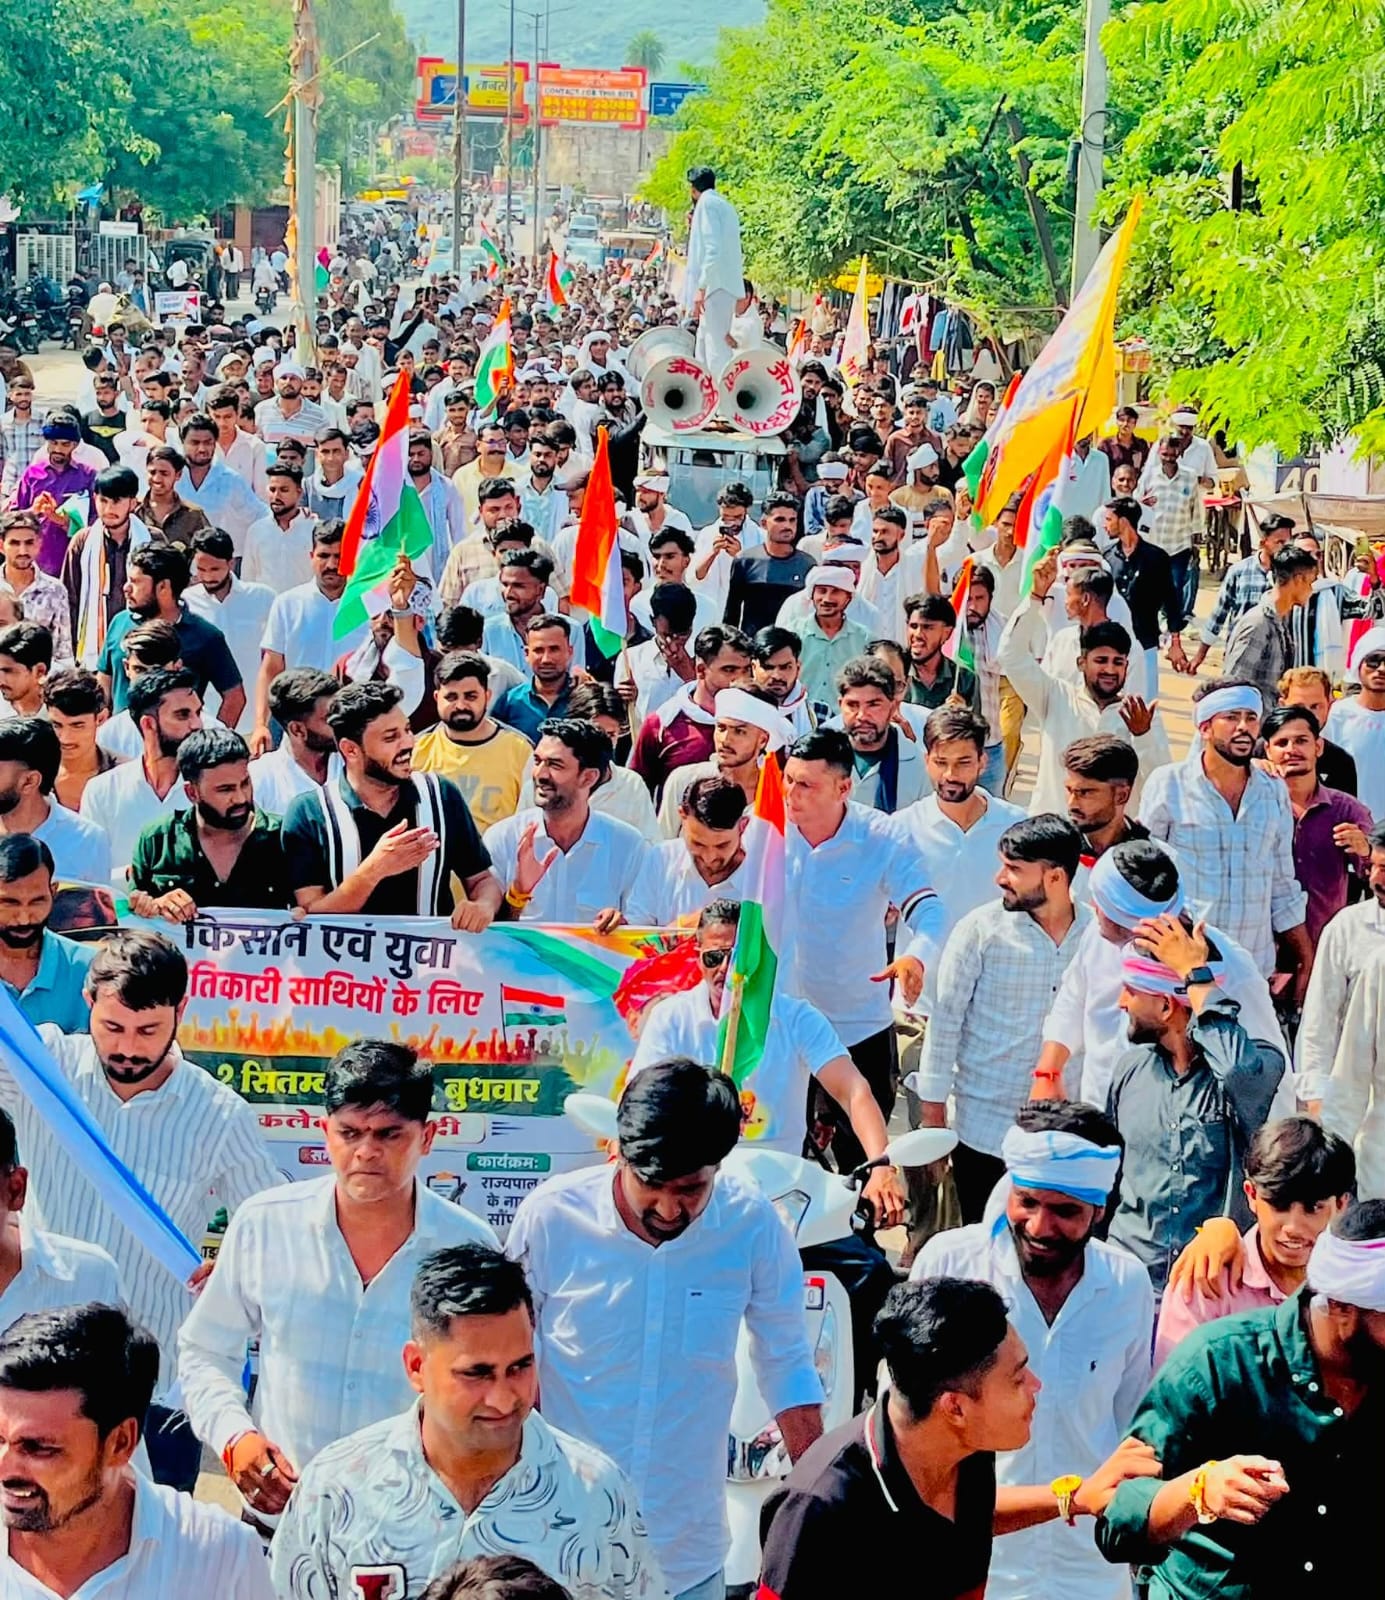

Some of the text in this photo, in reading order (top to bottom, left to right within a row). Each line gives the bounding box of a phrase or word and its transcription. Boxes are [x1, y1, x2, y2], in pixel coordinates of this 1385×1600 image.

[545, 87, 579, 96] CONTACT
[767, 360, 795, 396] जैन
[320, 923, 376, 962] एवं
[384, 932, 457, 979] युवा
[188, 960, 484, 1016] तिकारी साथियों के लिए
[444, 1077, 540, 1111] बुधवार
[481, 1176, 539, 1190] राज्यपाल
[486, 1192, 525, 1208] के ना
